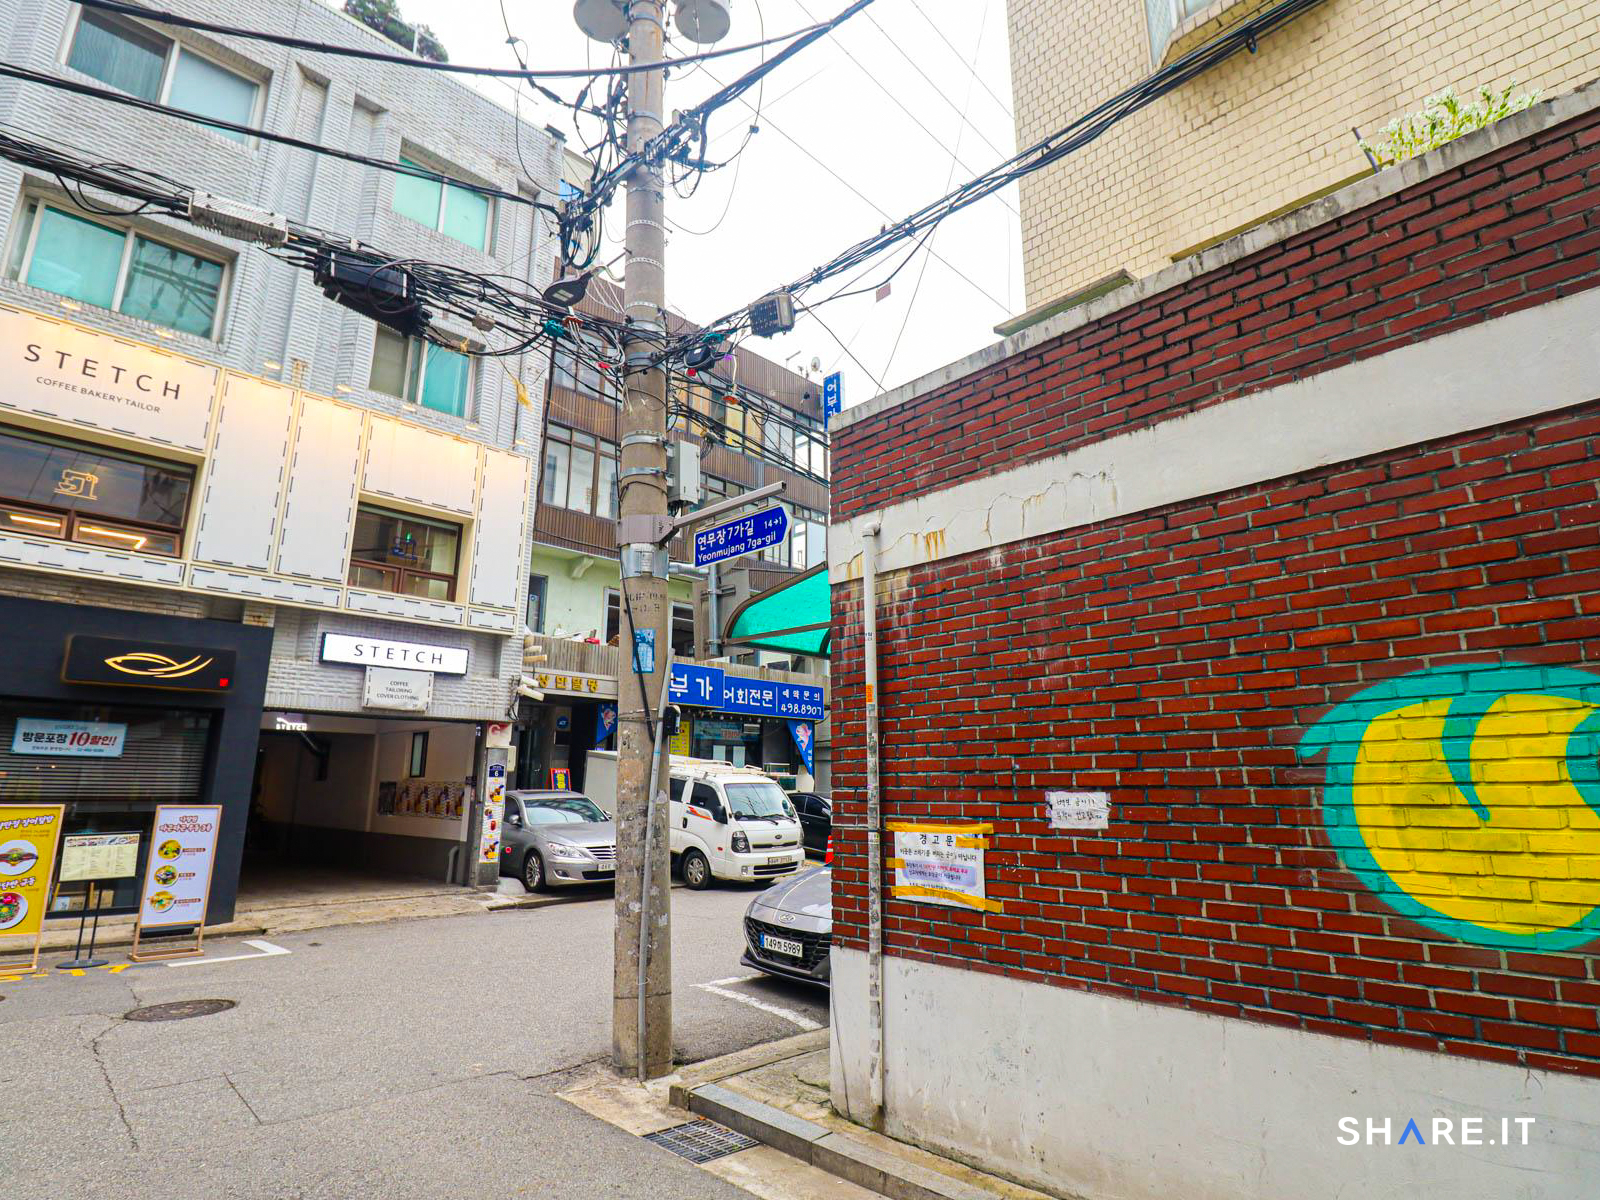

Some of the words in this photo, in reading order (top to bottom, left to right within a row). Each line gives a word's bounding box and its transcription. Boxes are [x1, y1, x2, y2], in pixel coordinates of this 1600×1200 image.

[24, 344, 181, 400] STETCH
[36, 376, 78, 393] COFFEE
[80, 387, 123, 403] BAKERY
[124, 398, 161, 414] TAILOR
[697, 543, 745, 563] Yeonmujang
[747, 530, 776, 549] 7ga-gil
[353, 644, 443, 665] STETCH
[22, 731, 68, 744] 방문포장
[783, 941, 801, 955] 5989
